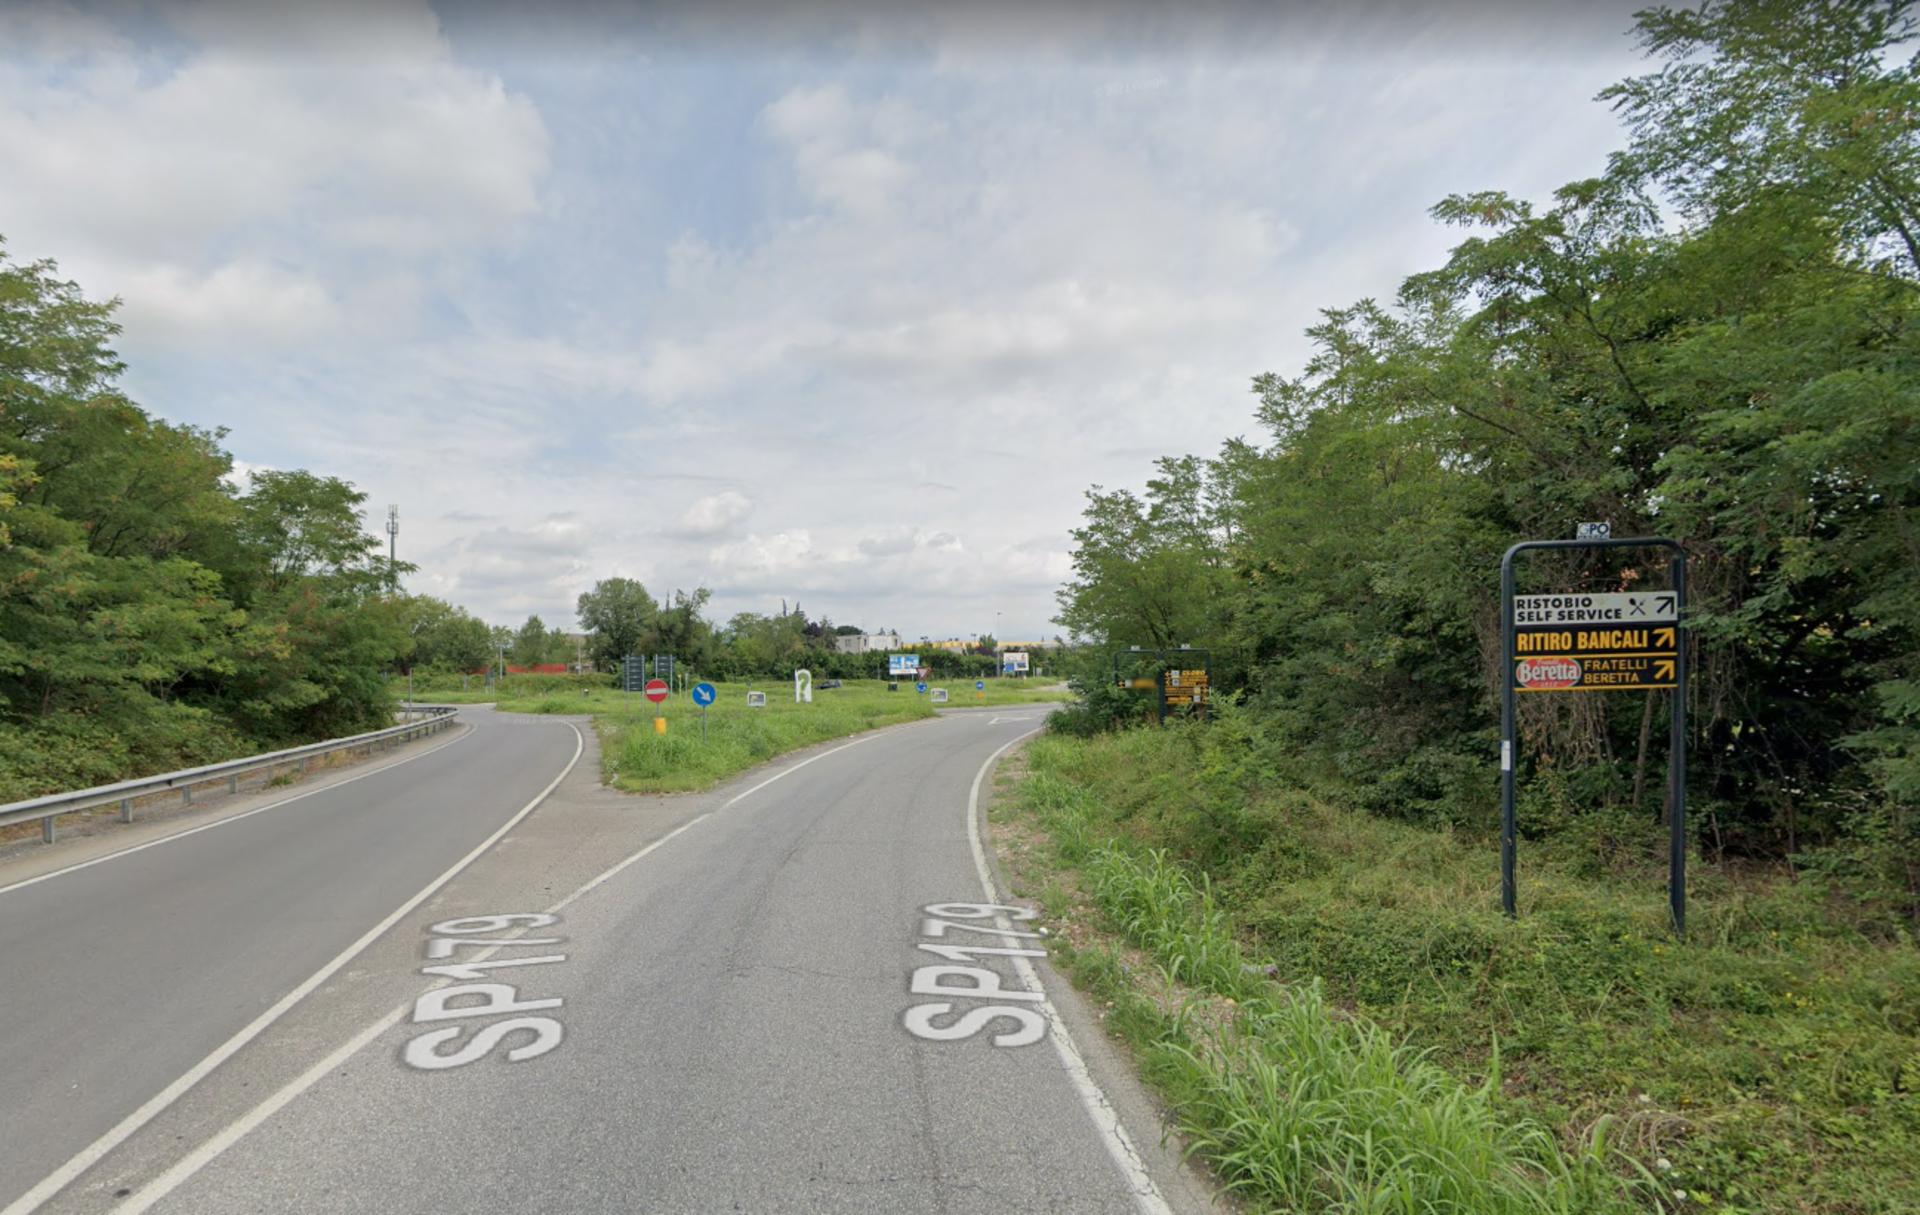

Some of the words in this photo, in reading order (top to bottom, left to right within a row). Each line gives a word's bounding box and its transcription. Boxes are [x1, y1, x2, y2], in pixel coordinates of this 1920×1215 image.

[1516, 597, 1593, 609] RISTOBIO
[1517, 610, 1553, 622] SELF
[1557, 608, 1622, 621] SERVICE
[1517, 631, 1572, 651] RITIRO
[1577, 630, 1648, 650] BANCALI
[1584, 659, 1648, 670] FRATELLI
[1520, 662, 1577, 683] Beretta
[1584, 672, 1640, 684] BERETTA
